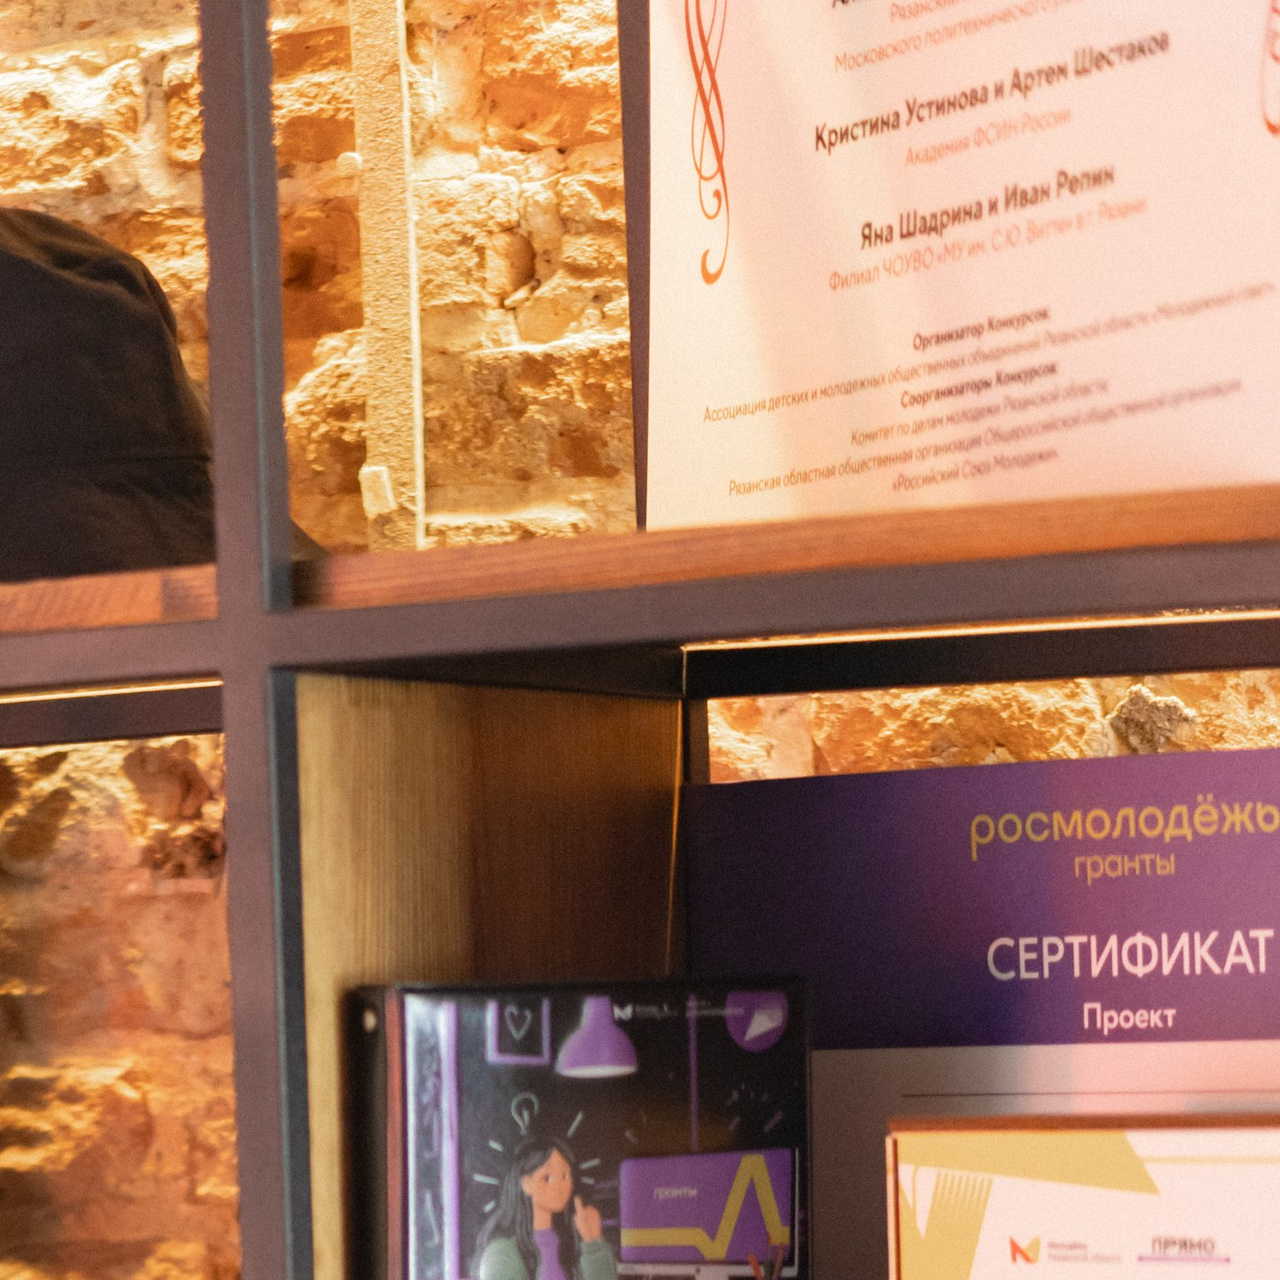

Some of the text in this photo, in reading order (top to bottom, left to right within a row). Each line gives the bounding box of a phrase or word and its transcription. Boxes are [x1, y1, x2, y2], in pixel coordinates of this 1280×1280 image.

[835, 35, 921, 72] Московского
[814, 29, 1171, 155] Кристина Устинова и Артем Шестаков
[905, 134, 971, 167] Академия
[860, 162, 1116, 251] Яна Шадрина и Иван Репин
[828, 265, 880, 293] Филиал
[913, 319, 985, 353] Организатор
[703, 395, 767, 424] Ассоциация
[767, 388, 810, 413] детских
[900, 376, 993, 410] Соорганизаторы
[850, 420, 895, 447] Комитет
[729, 468, 781, 497] Рязанская
[782, 459, 837, 489] областная
[838, 446, 913, 477] общественная
[969, 793, 1280, 861] росмолодёжь
[1074, 850, 1176, 885] гранты
[986, 929, 1275, 981] СЕРТИФИКАТ
[1083, 1002, 1176, 1036] Проект
